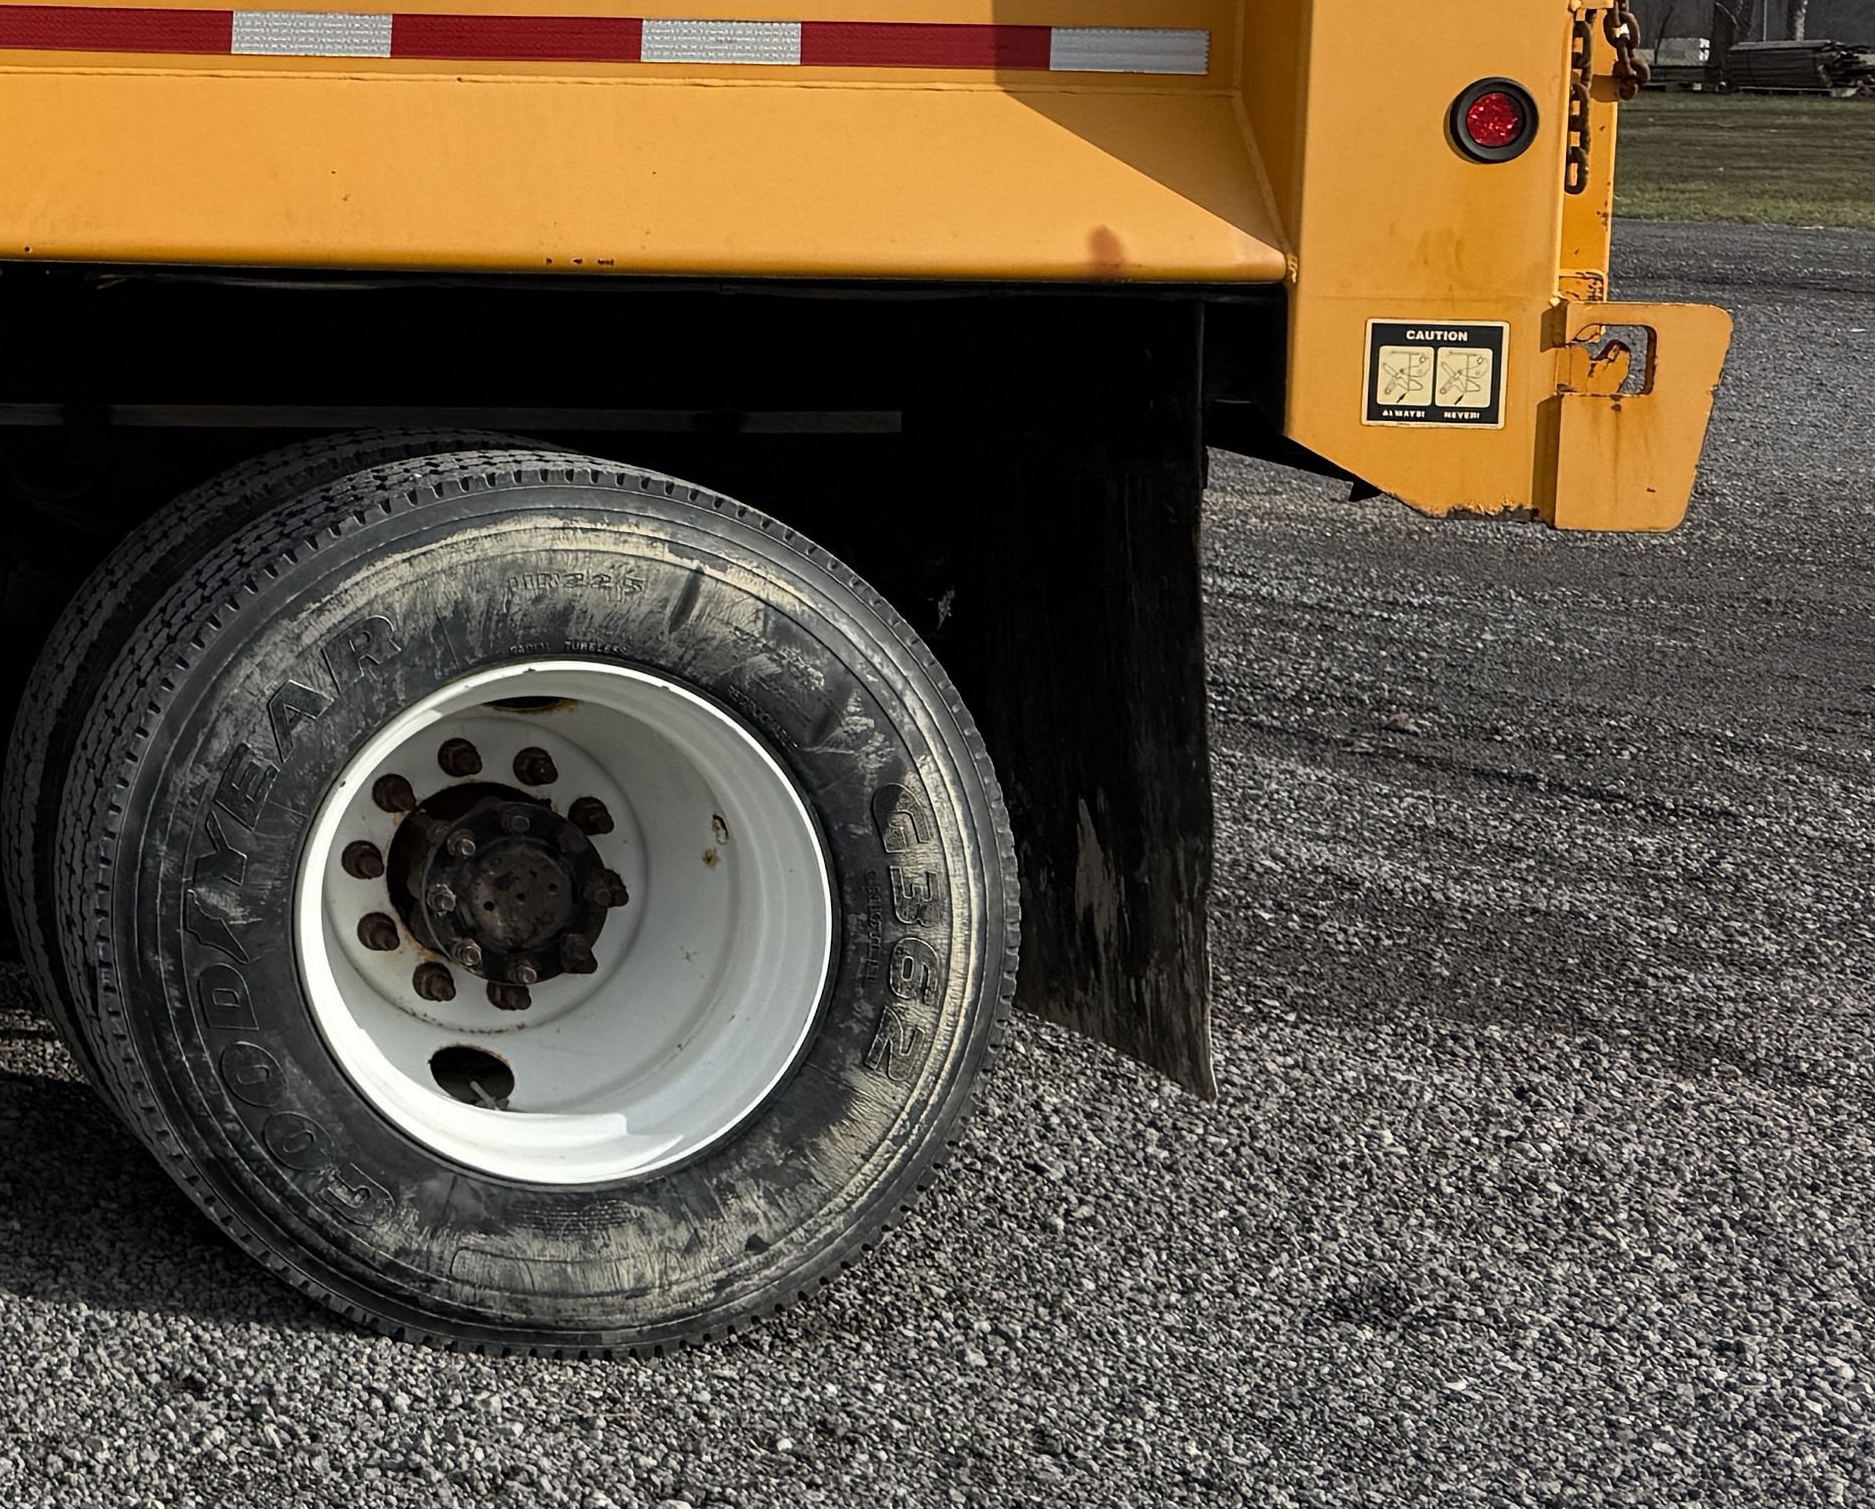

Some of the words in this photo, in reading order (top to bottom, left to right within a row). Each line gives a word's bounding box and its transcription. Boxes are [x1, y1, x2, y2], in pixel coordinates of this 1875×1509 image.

[1406, 329, 1468, 341] CAUTION
[186, 613, 403, 1227] GOODYEAR
[864, 783, 940, 1081] G362
